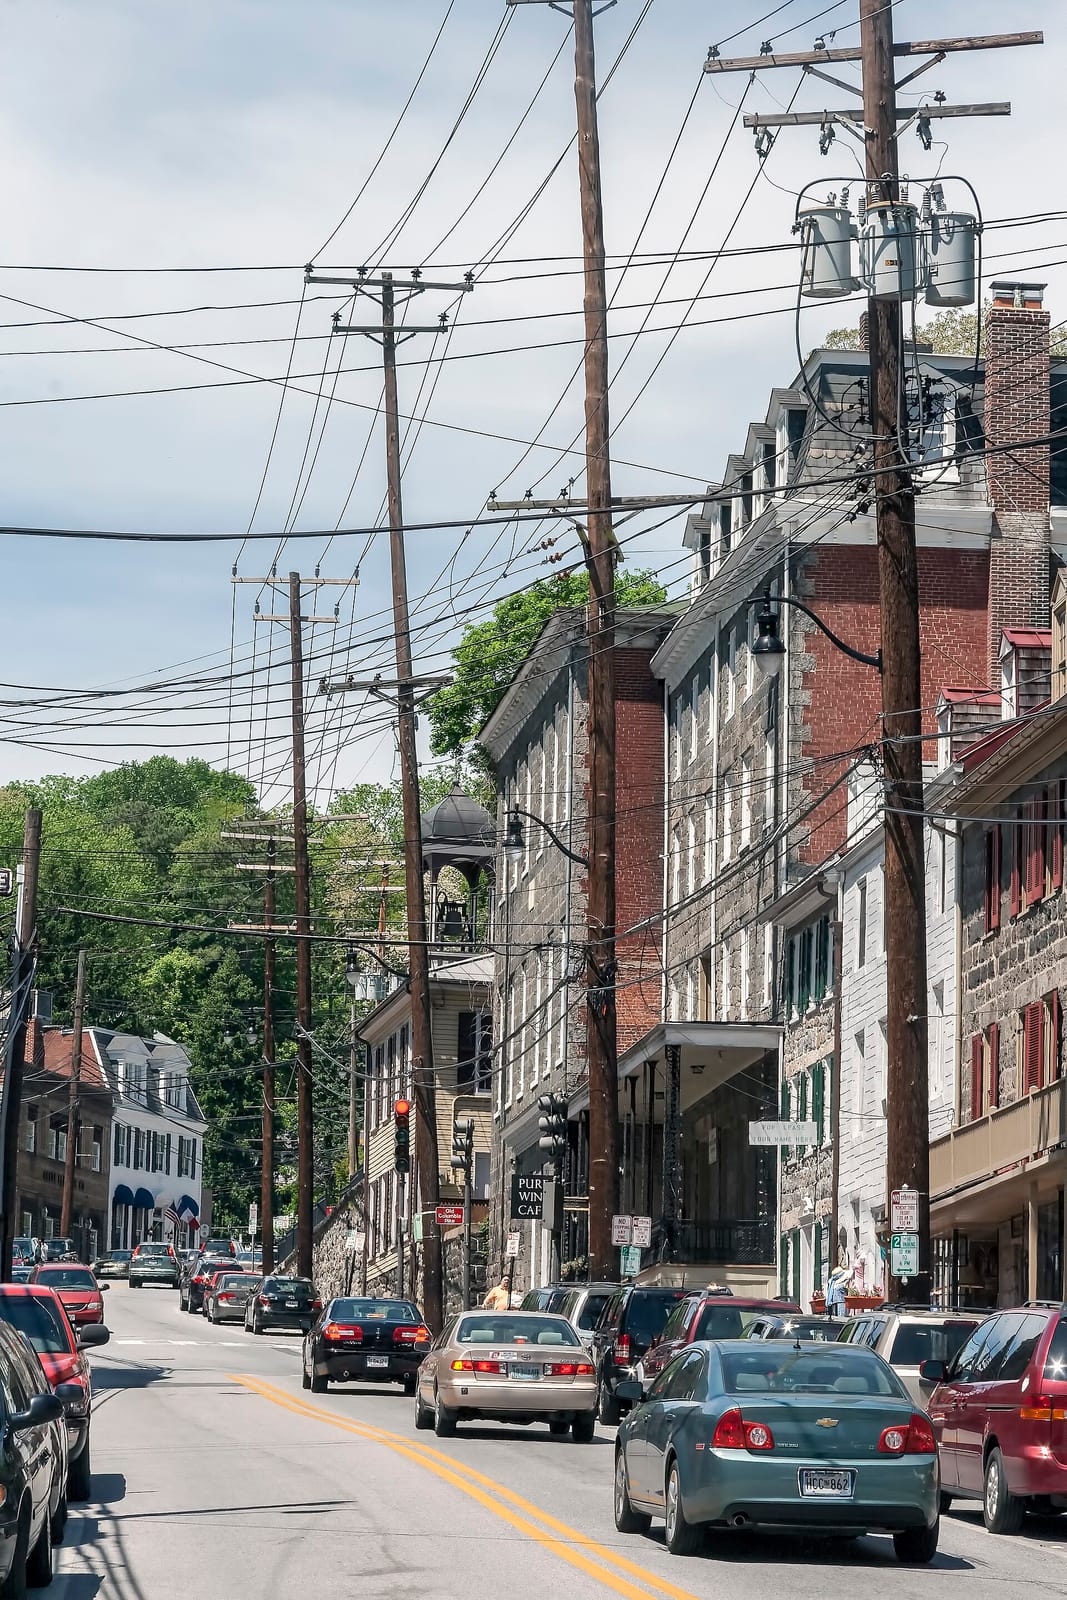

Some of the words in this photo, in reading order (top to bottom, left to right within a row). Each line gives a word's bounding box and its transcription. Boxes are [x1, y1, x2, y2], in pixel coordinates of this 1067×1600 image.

[518, 1178, 548, 1189] PUR
[518, 1191, 543, 1202] WIN
[518, 1205, 542, 1215] CAF
[894, 1236, 900, 1247] 2
[623, 1247, 628, 1255] 2
[830, 1478, 849, 1491] 862
